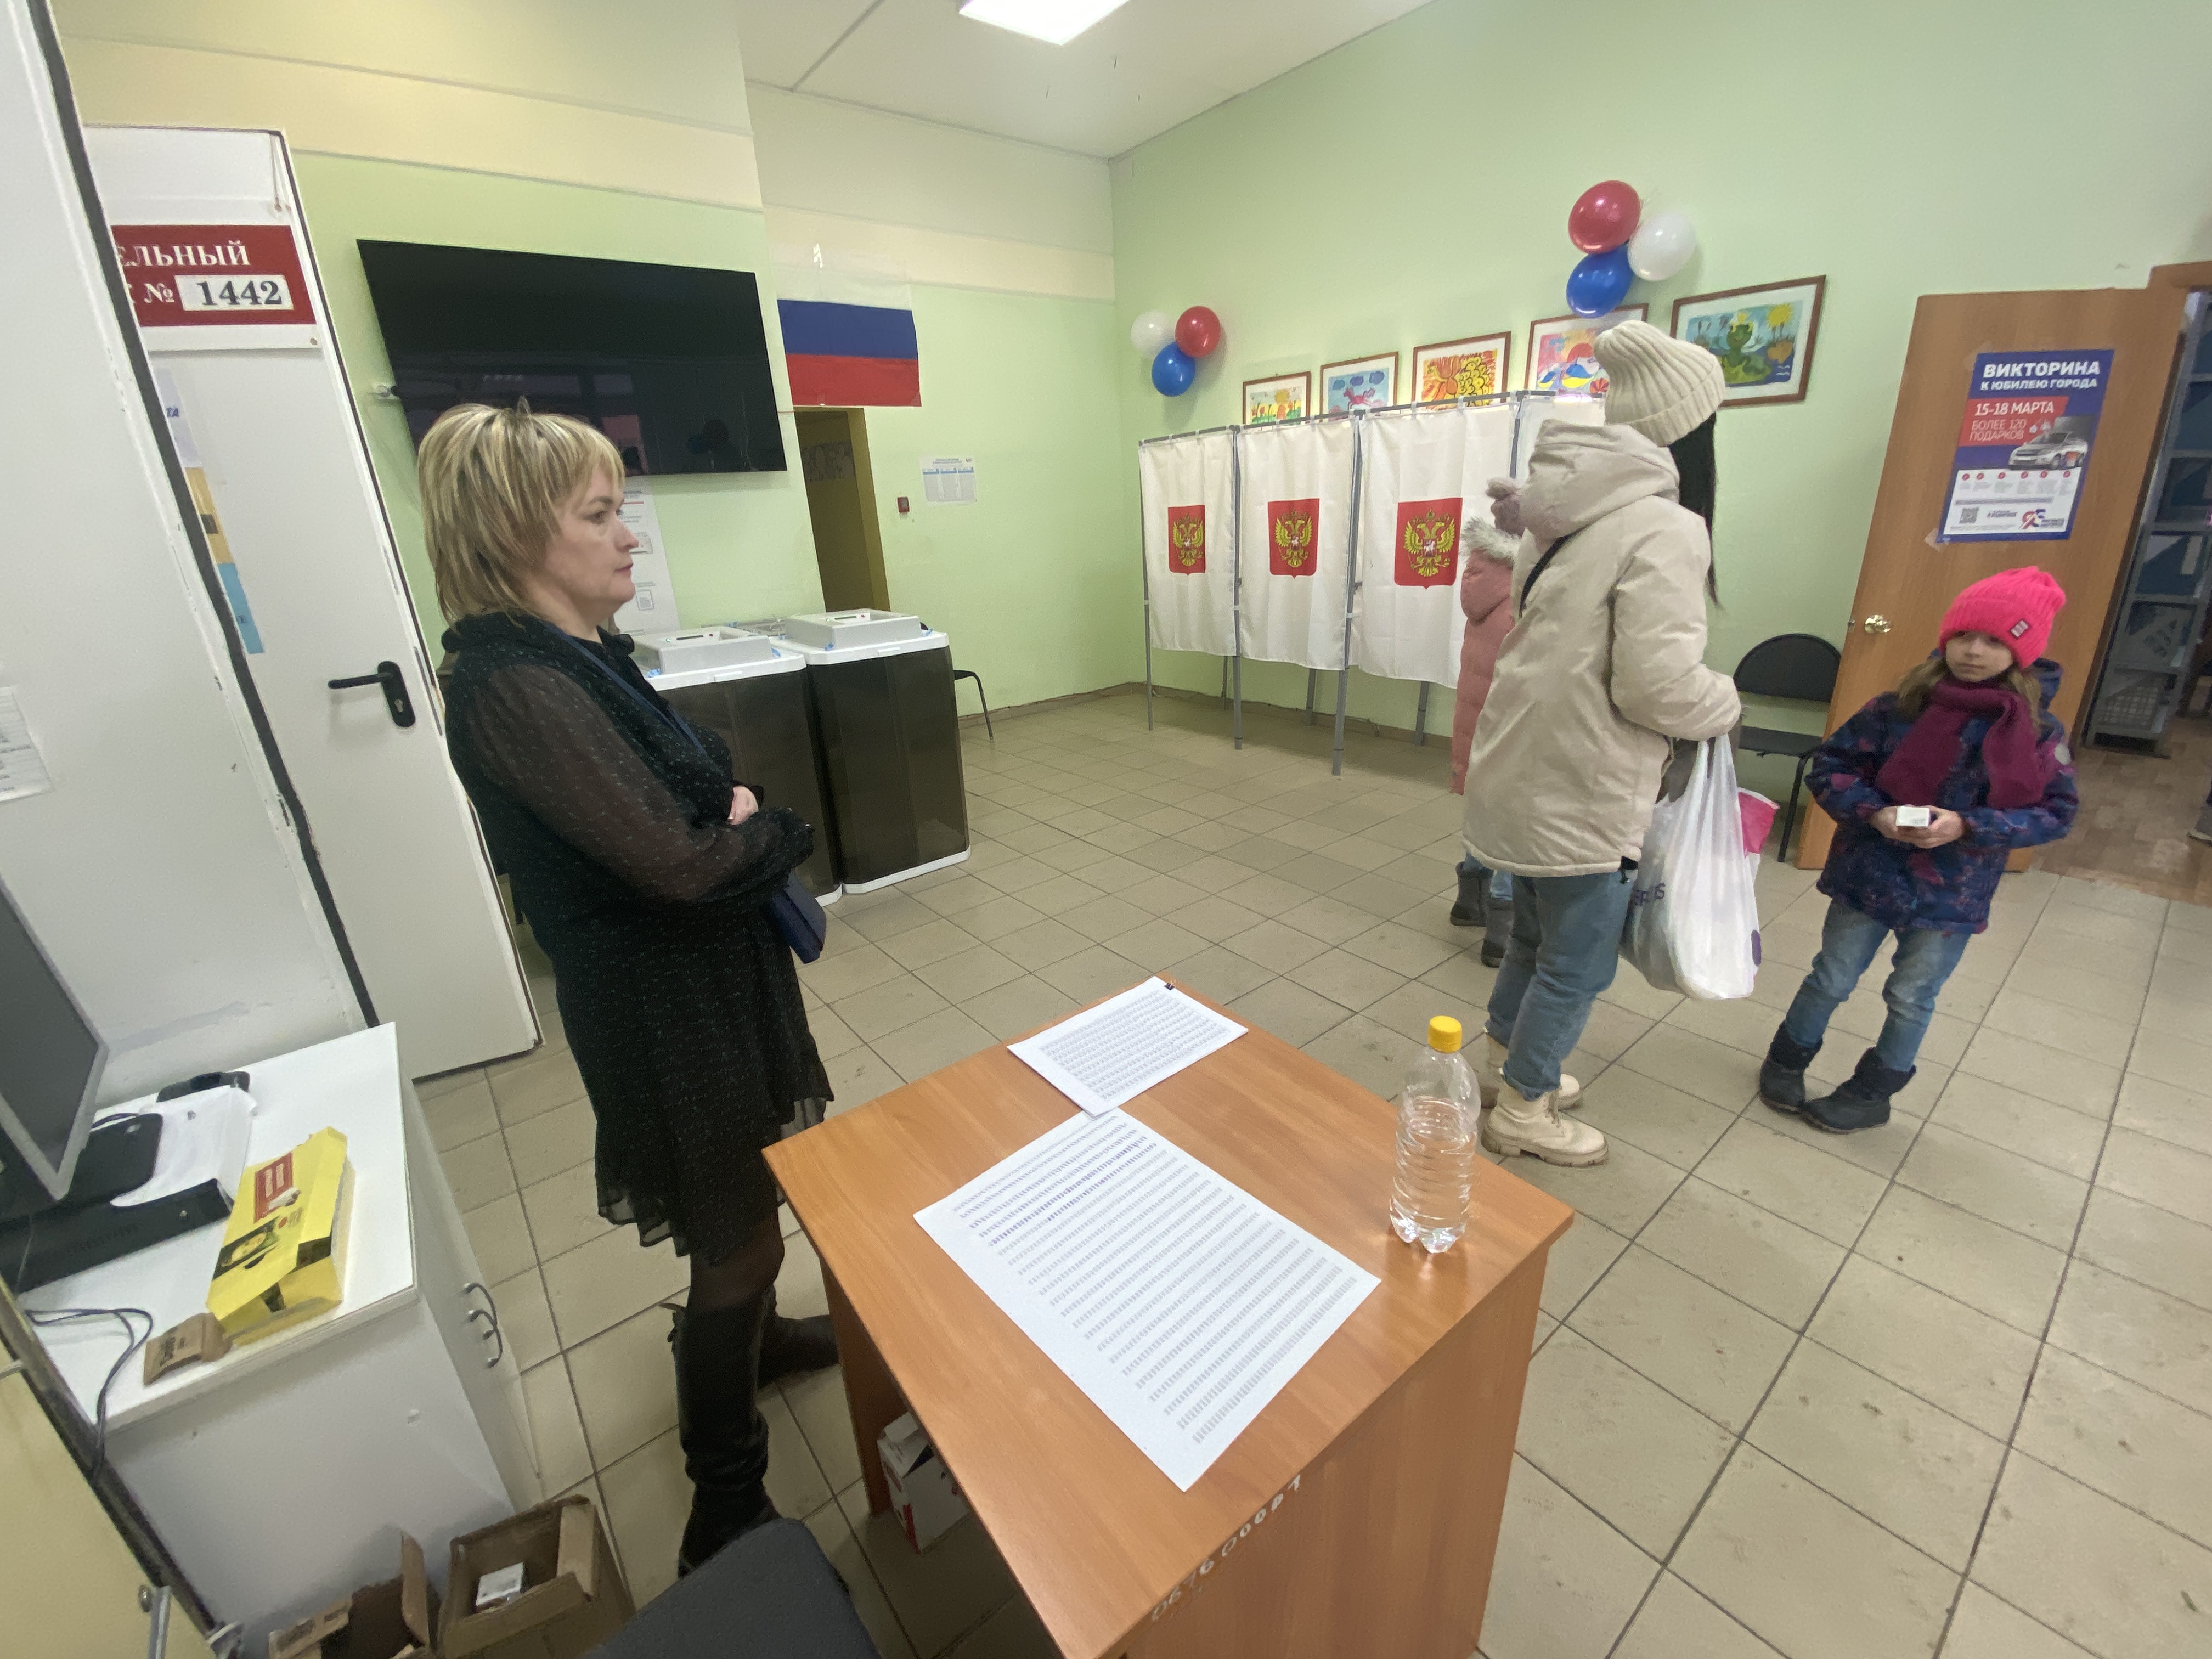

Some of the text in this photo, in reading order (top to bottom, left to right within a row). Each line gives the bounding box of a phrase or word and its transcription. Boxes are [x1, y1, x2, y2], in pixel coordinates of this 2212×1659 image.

[195, 280, 283, 306] 1442
[1983, 360, 2101, 378] ВИКТОРИНА
[1980, 377, 2098, 391] К ЮБИЛЕЮ ГОРОДА
[1974, 400, 2055, 416] 15-18 МАРТА
[1971, 419, 2028, 431] БОЛЕЕ 120
[1969, 430, 2025, 442] ПОДАРКОВ
